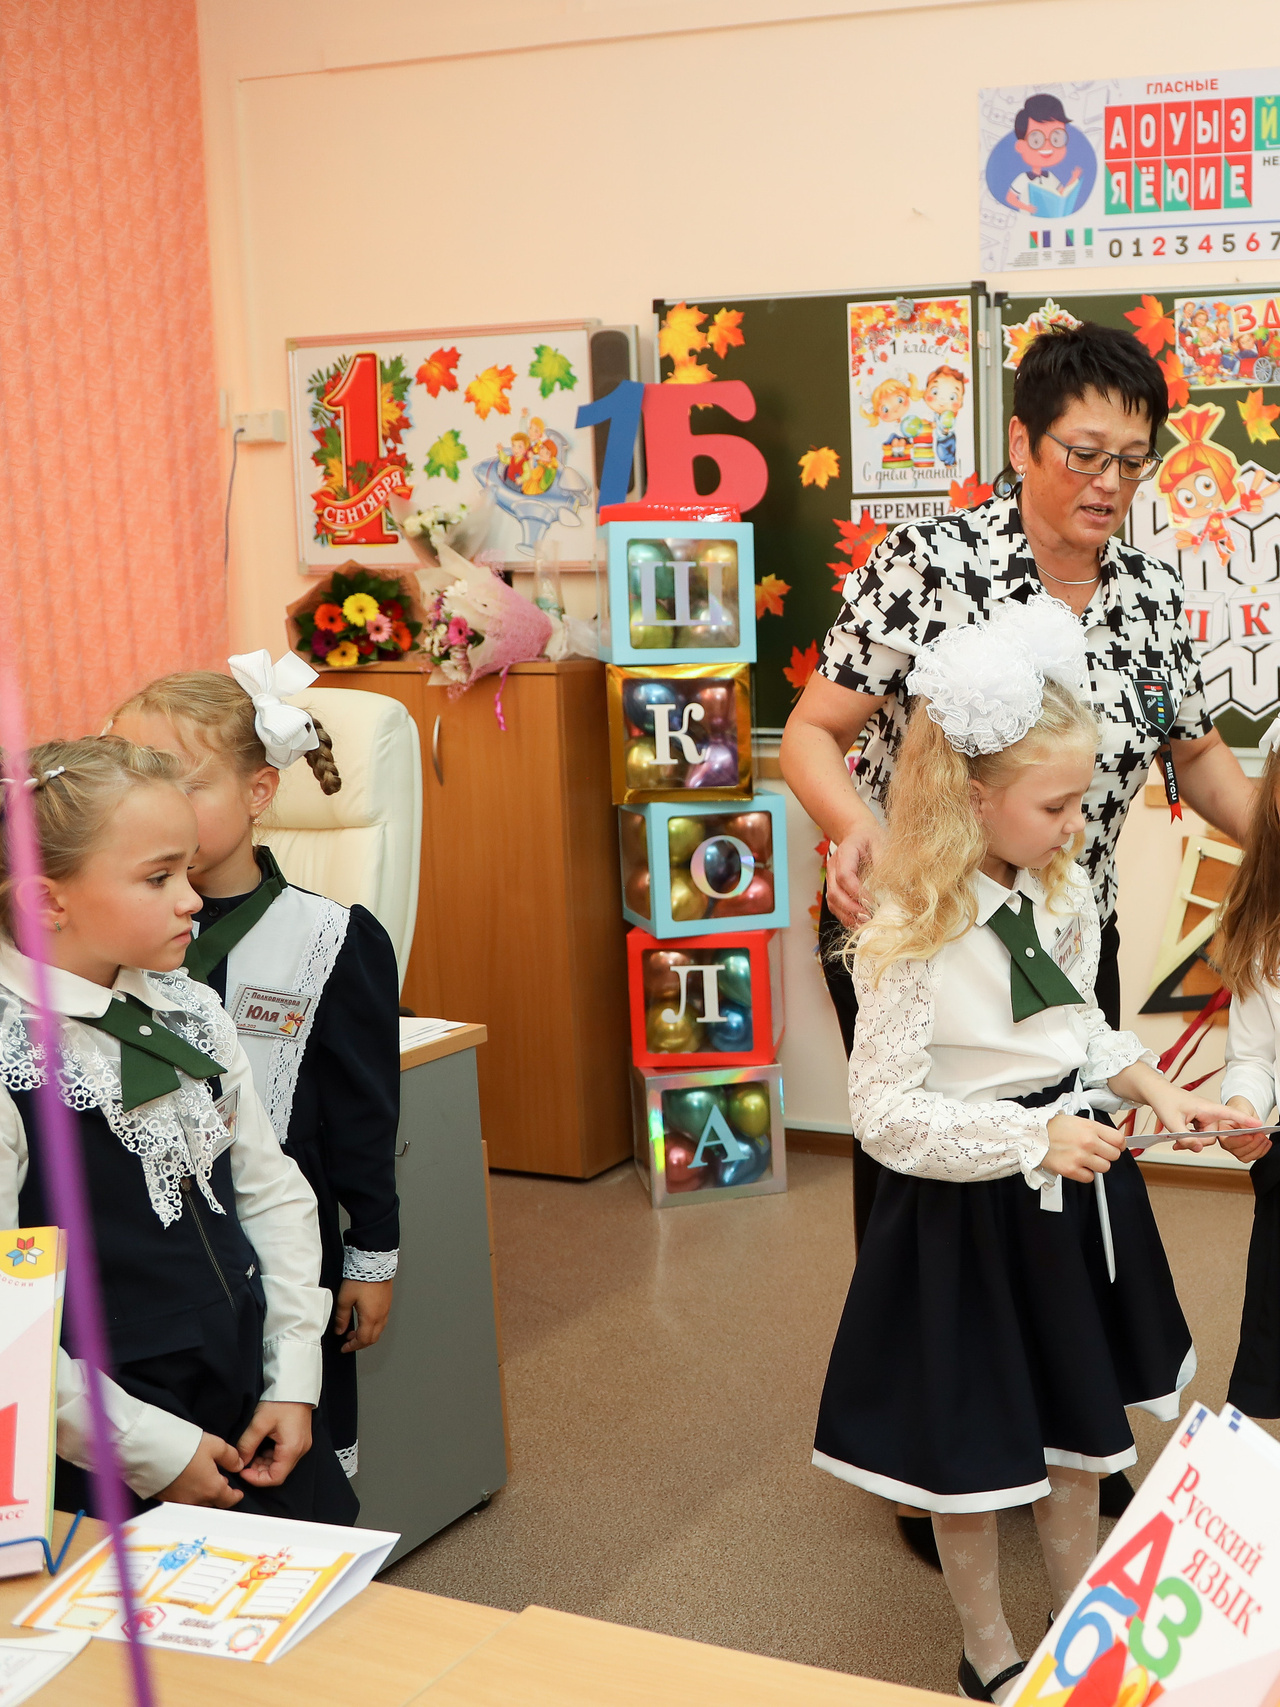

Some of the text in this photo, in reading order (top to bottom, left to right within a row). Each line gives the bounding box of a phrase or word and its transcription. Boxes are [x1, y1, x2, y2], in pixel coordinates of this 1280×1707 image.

[1146, 78, 1219, 95] ГЛАСНЫЕ
[1108, 238, 1122, 257] 0
[1132, 237, 1143, 256] 1
[1152, 236, 1166, 256] 2
[1175, 235, 1189, 255] 3
[1198, 234, 1213, 254] 4
[1222, 233, 1236, 253] 5
[1246, 232, 1260, 252] 6
[889, 339, 897, 355] 1
[323, 470, 404, 526] СЕНТЯБРЯ
[1165, 761, 1178, 801] SEE YOU
[246, 1004, 280, 1023] Юля
[1166, 1462, 1267, 1580] Русский
[1181, 1548, 1264, 1637] ЯЗЫК
